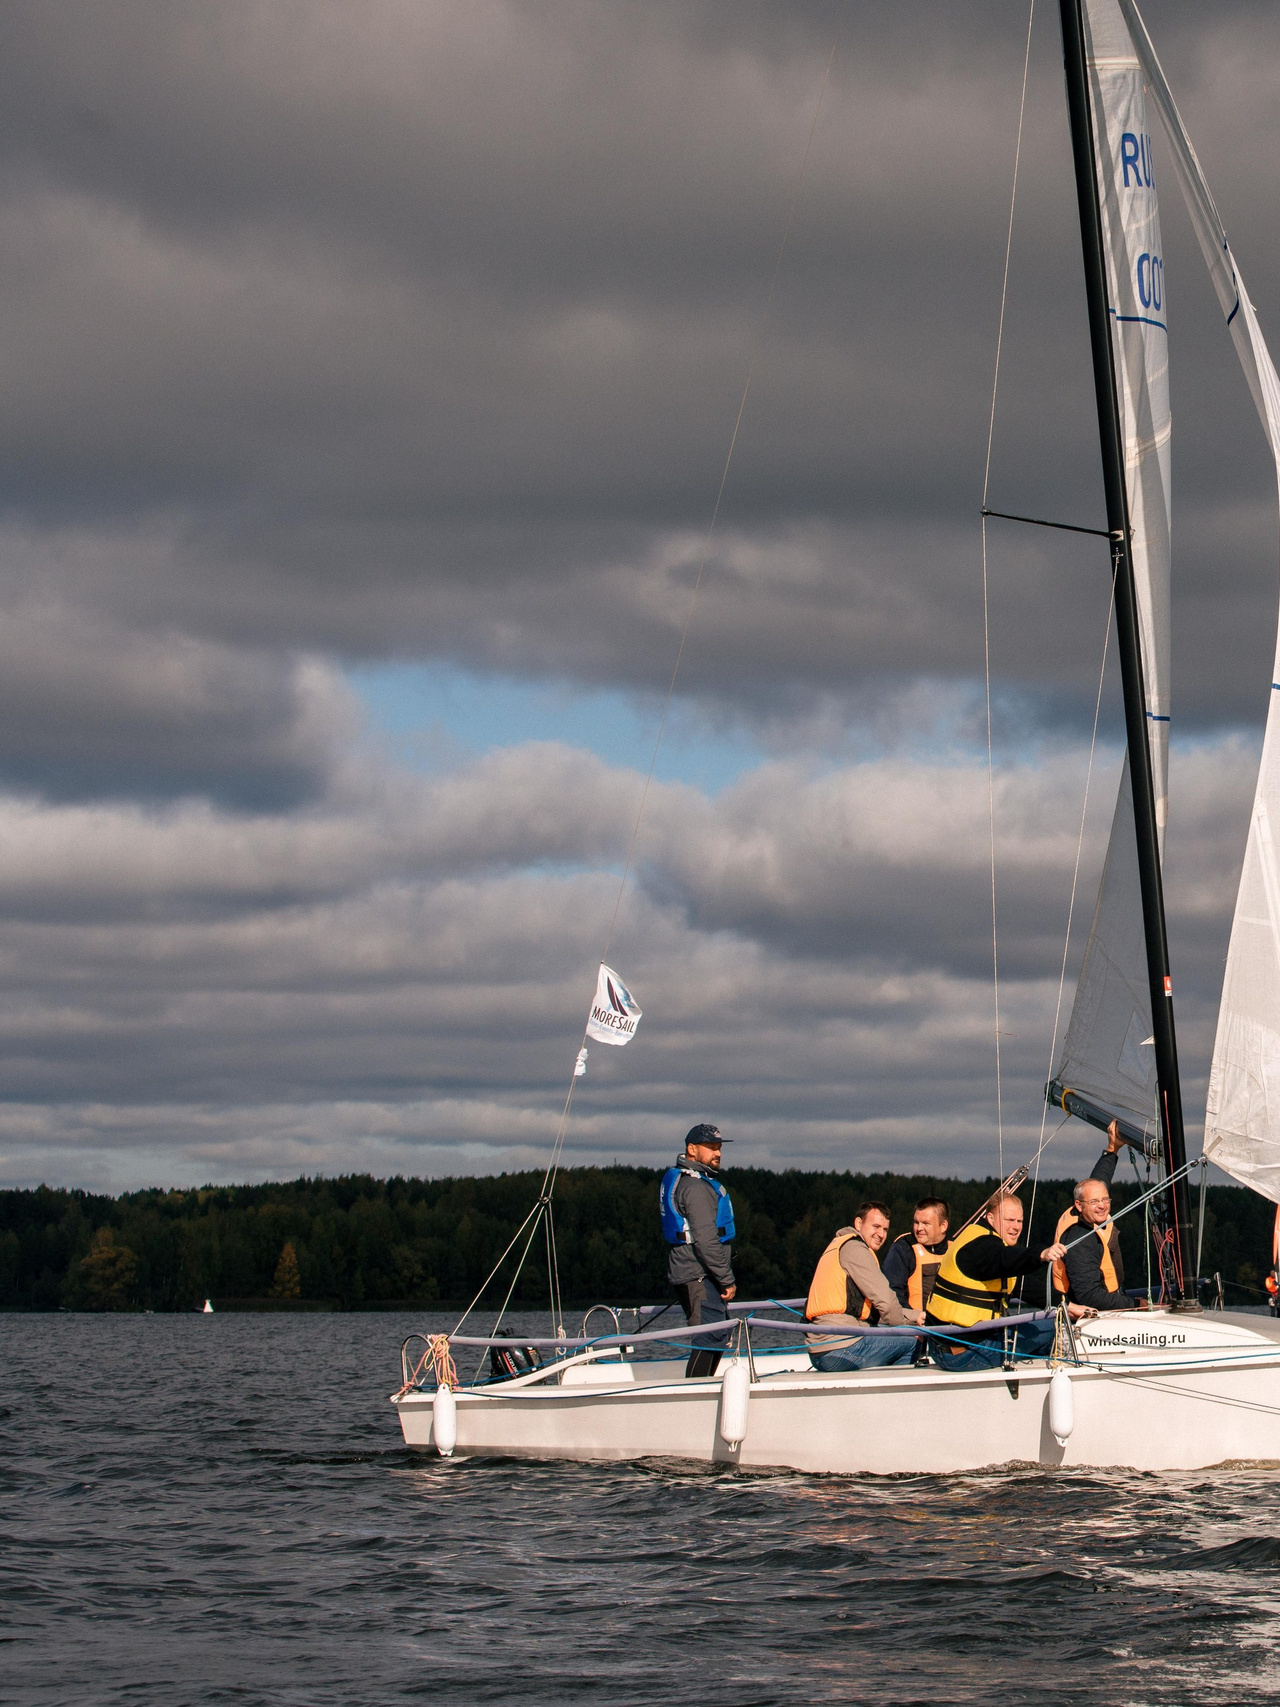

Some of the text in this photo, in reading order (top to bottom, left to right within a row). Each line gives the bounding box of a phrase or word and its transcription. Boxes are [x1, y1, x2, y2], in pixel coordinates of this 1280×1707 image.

[1137, 253, 1164, 311] 00
[591, 1005, 636, 1034] MORESAIL
[1087, 1333, 1186, 1347] windsailing.ru
